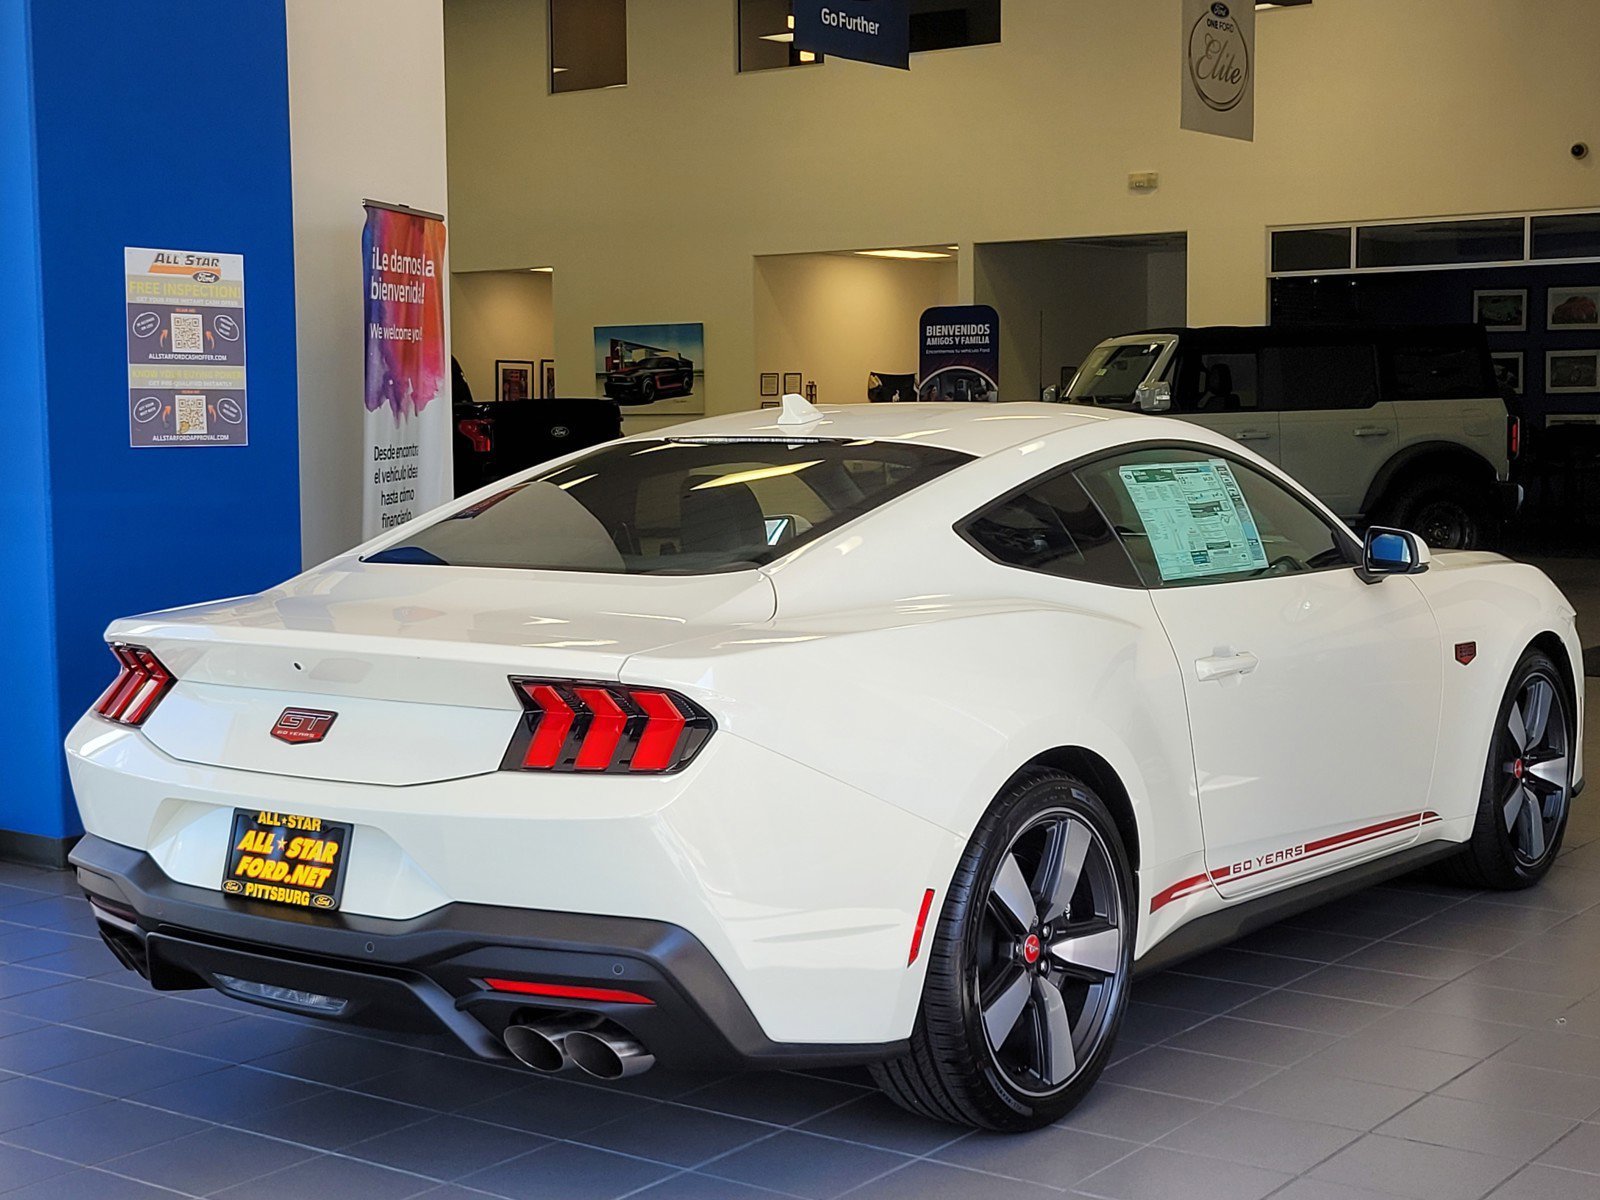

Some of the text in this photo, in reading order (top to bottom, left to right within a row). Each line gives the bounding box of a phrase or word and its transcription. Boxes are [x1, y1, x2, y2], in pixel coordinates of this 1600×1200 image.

[821, 8, 880, 35] Go Further
[1207, 18, 1219, 30] ONE
[1196, 32, 1242, 85] Elite
[154, 252, 219, 267] ALL STAR
[390, 249, 421, 276] damos
[422, 253, 435, 278] la
[128, 281, 160, 296] FREE
[370, 276, 425, 305] bienvenida!
[370, 323, 383, 339] We
[383, 325, 411, 341] welcome
[926, 323, 990, 337] BIENVENIDOS
[926, 335, 990, 346] AMIGOS Y FAMILIA
[373, 444, 395, 461] Desde
[374, 468, 380, 484] el
[382, 465, 407, 483] vehículo
[381, 490, 398, 506] hasta
[277, 710, 332, 731] GT
[257, 810, 322, 832] ALL STAR
[236, 829, 339, 864] ALL STAR
[1232, 845, 1303, 875] 60 YEARS
[235, 855, 333, 889] FORD.NET
[244, 882, 311, 906] PITTSBURG
